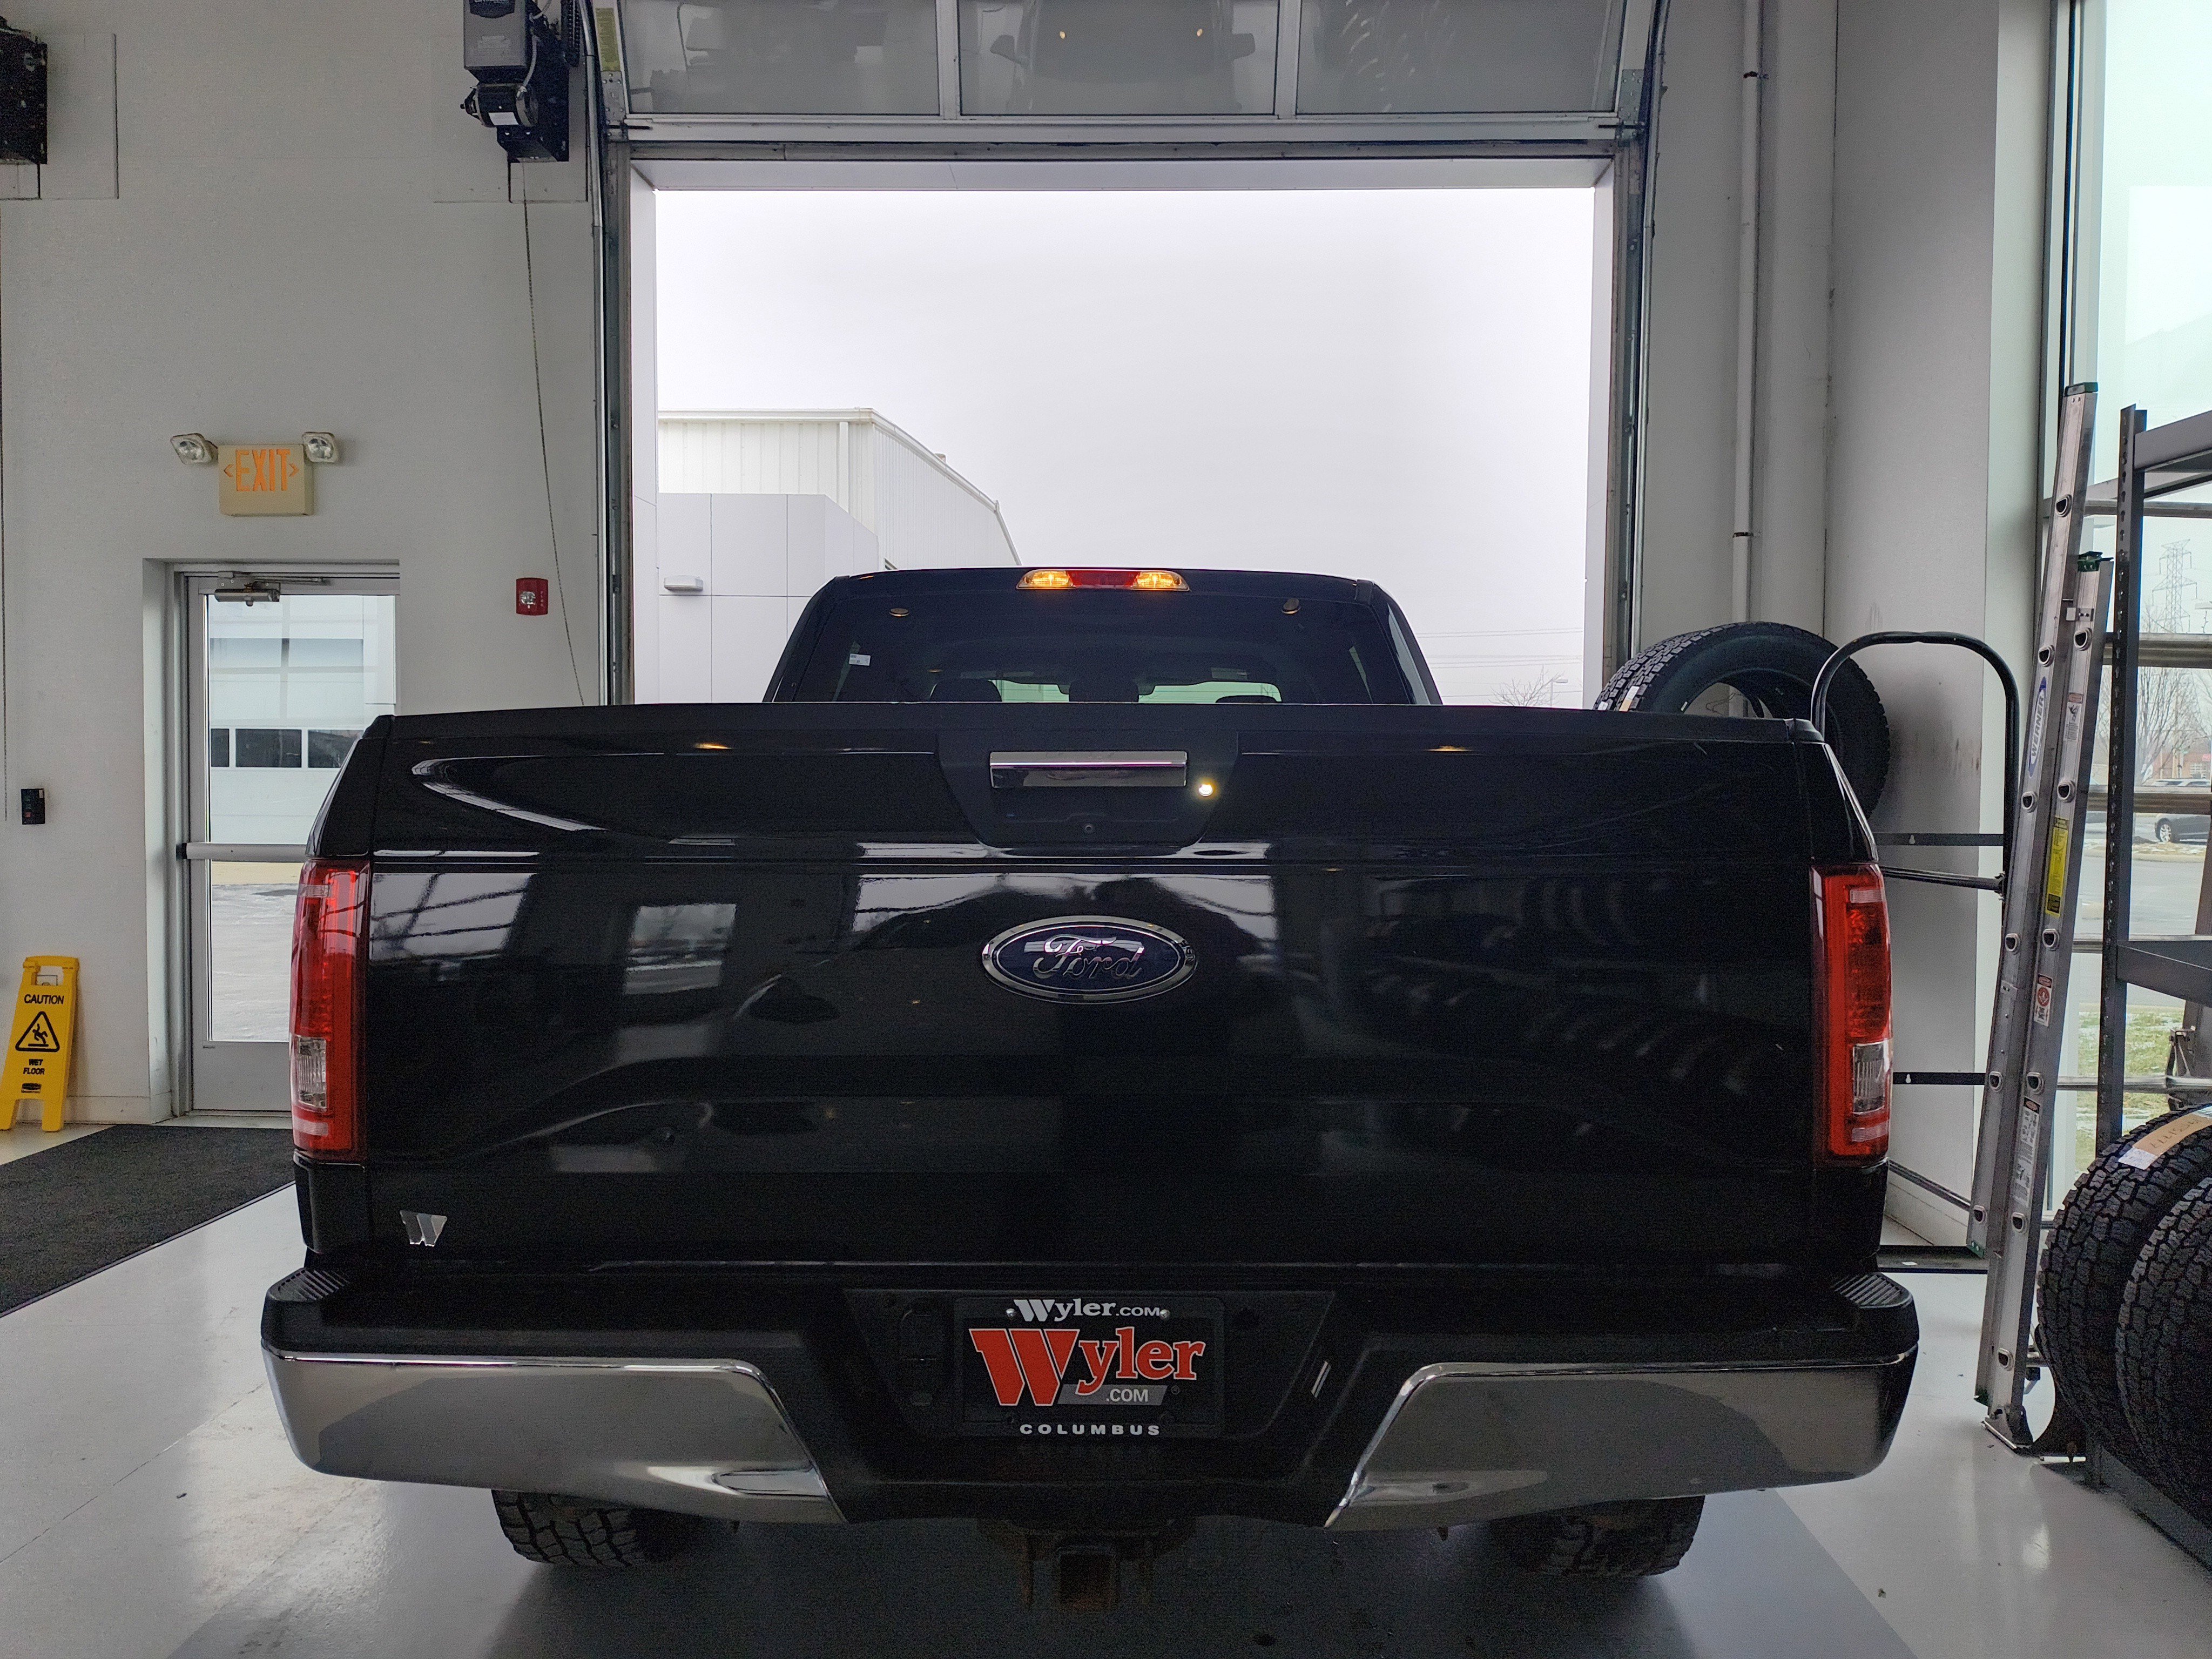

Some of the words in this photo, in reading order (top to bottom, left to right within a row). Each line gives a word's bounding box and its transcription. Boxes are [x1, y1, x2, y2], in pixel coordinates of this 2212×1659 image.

[235, 449, 291, 491] EXIT
[2031, 695, 2044, 757] WERNER
[1033, 934, 1145, 979] Ford
[24, 994, 64, 1004] CAUTION
[969, 1327, 1206, 1406] Wyler
[1106, 1389, 1148, 1402] .COM
[1020, 1424, 1159, 1435] COLUMBUS
